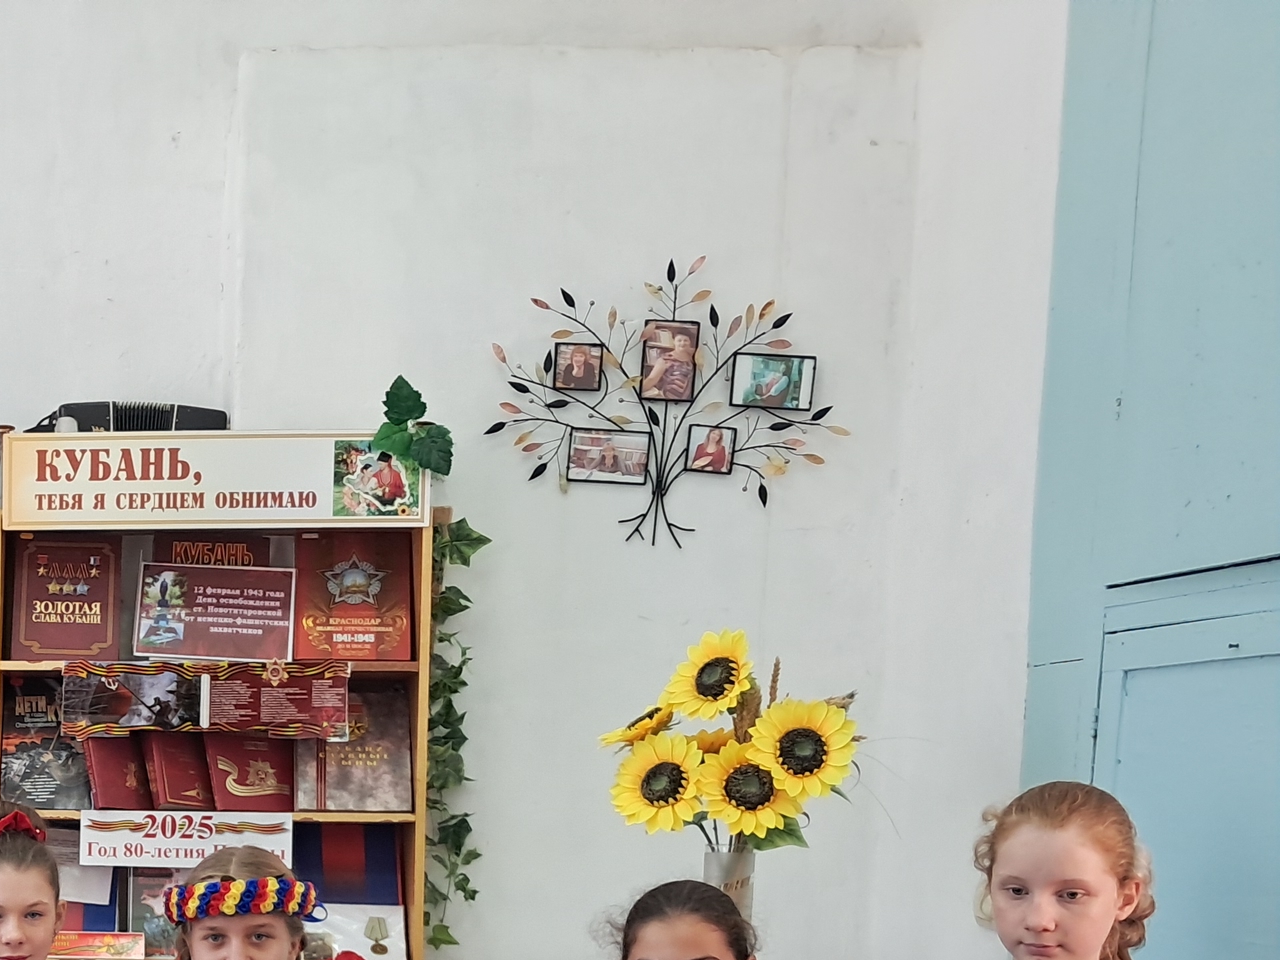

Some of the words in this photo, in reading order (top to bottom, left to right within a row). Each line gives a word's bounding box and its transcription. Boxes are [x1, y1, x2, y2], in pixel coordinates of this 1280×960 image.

[35, 448, 202, 485] КУБАНЬ,
[35, 493, 83, 510] ТЕБЯ
[92, 493, 106, 510] Я
[116, 491, 205, 512] СЕРДЦЕМ
[215, 490, 317, 509] ОБНИМАЮ
[172, 541, 254, 566] КУБАНЬ
[193, 586, 203, 594] 12
[243, 589, 263, 597] 1943
[265, 590, 285, 598] года
[195, 595, 217, 603] День
[32, 600, 101, 614] ЗОЛОТАЯ
[32, 613, 61, 623] СЛАВА
[63, 614, 101, 624] КУБАНИ
[329, 617, 381, 625] КРАСНОДАР
[332, 633, 375, 643] 1941-1945
[141, 813, 215, 840] 2025
[86, 841, 118, 859] Год
[123, 842, 206, 859] 80-летия
